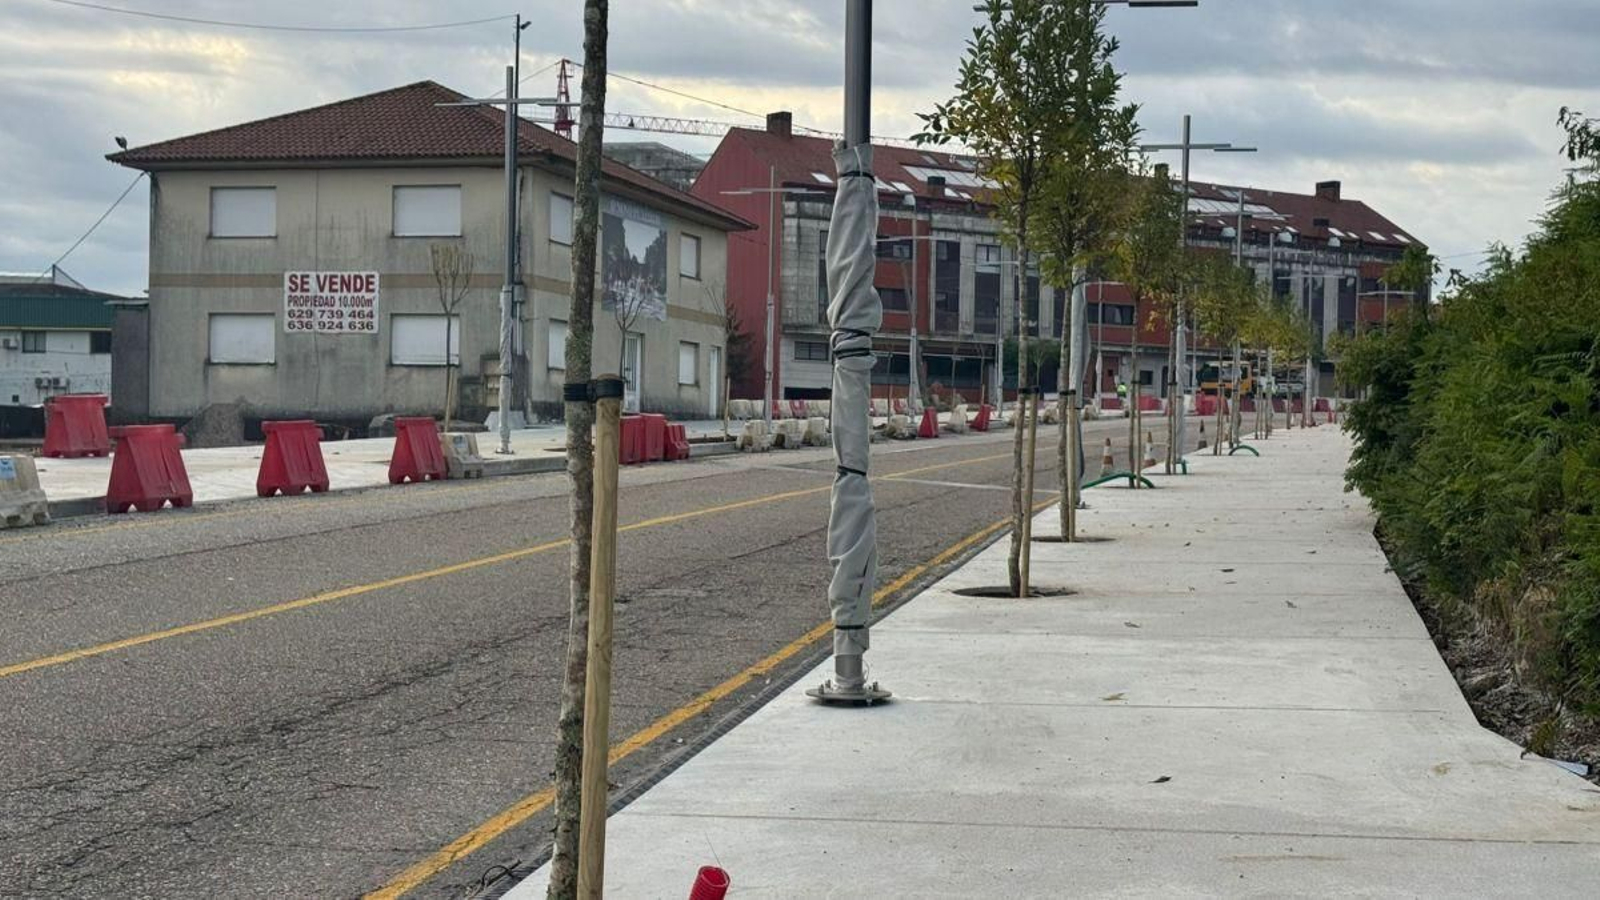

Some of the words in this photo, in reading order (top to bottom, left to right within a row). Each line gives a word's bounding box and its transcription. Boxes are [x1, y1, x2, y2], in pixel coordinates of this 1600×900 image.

[288, 274, 310, 293] SE
[316, 274, 375, 293] VENDE
[287, 295, 336, 308] PROPIEDAD
[288, 309, 313, 319] 629
[318, 309, 344, 319] 739
[348, 310, 374, 319] 464
[288, 320, 313, 330] 636
[318, 321, 343, 330] 924
[348, 321, 374, 330] 636
